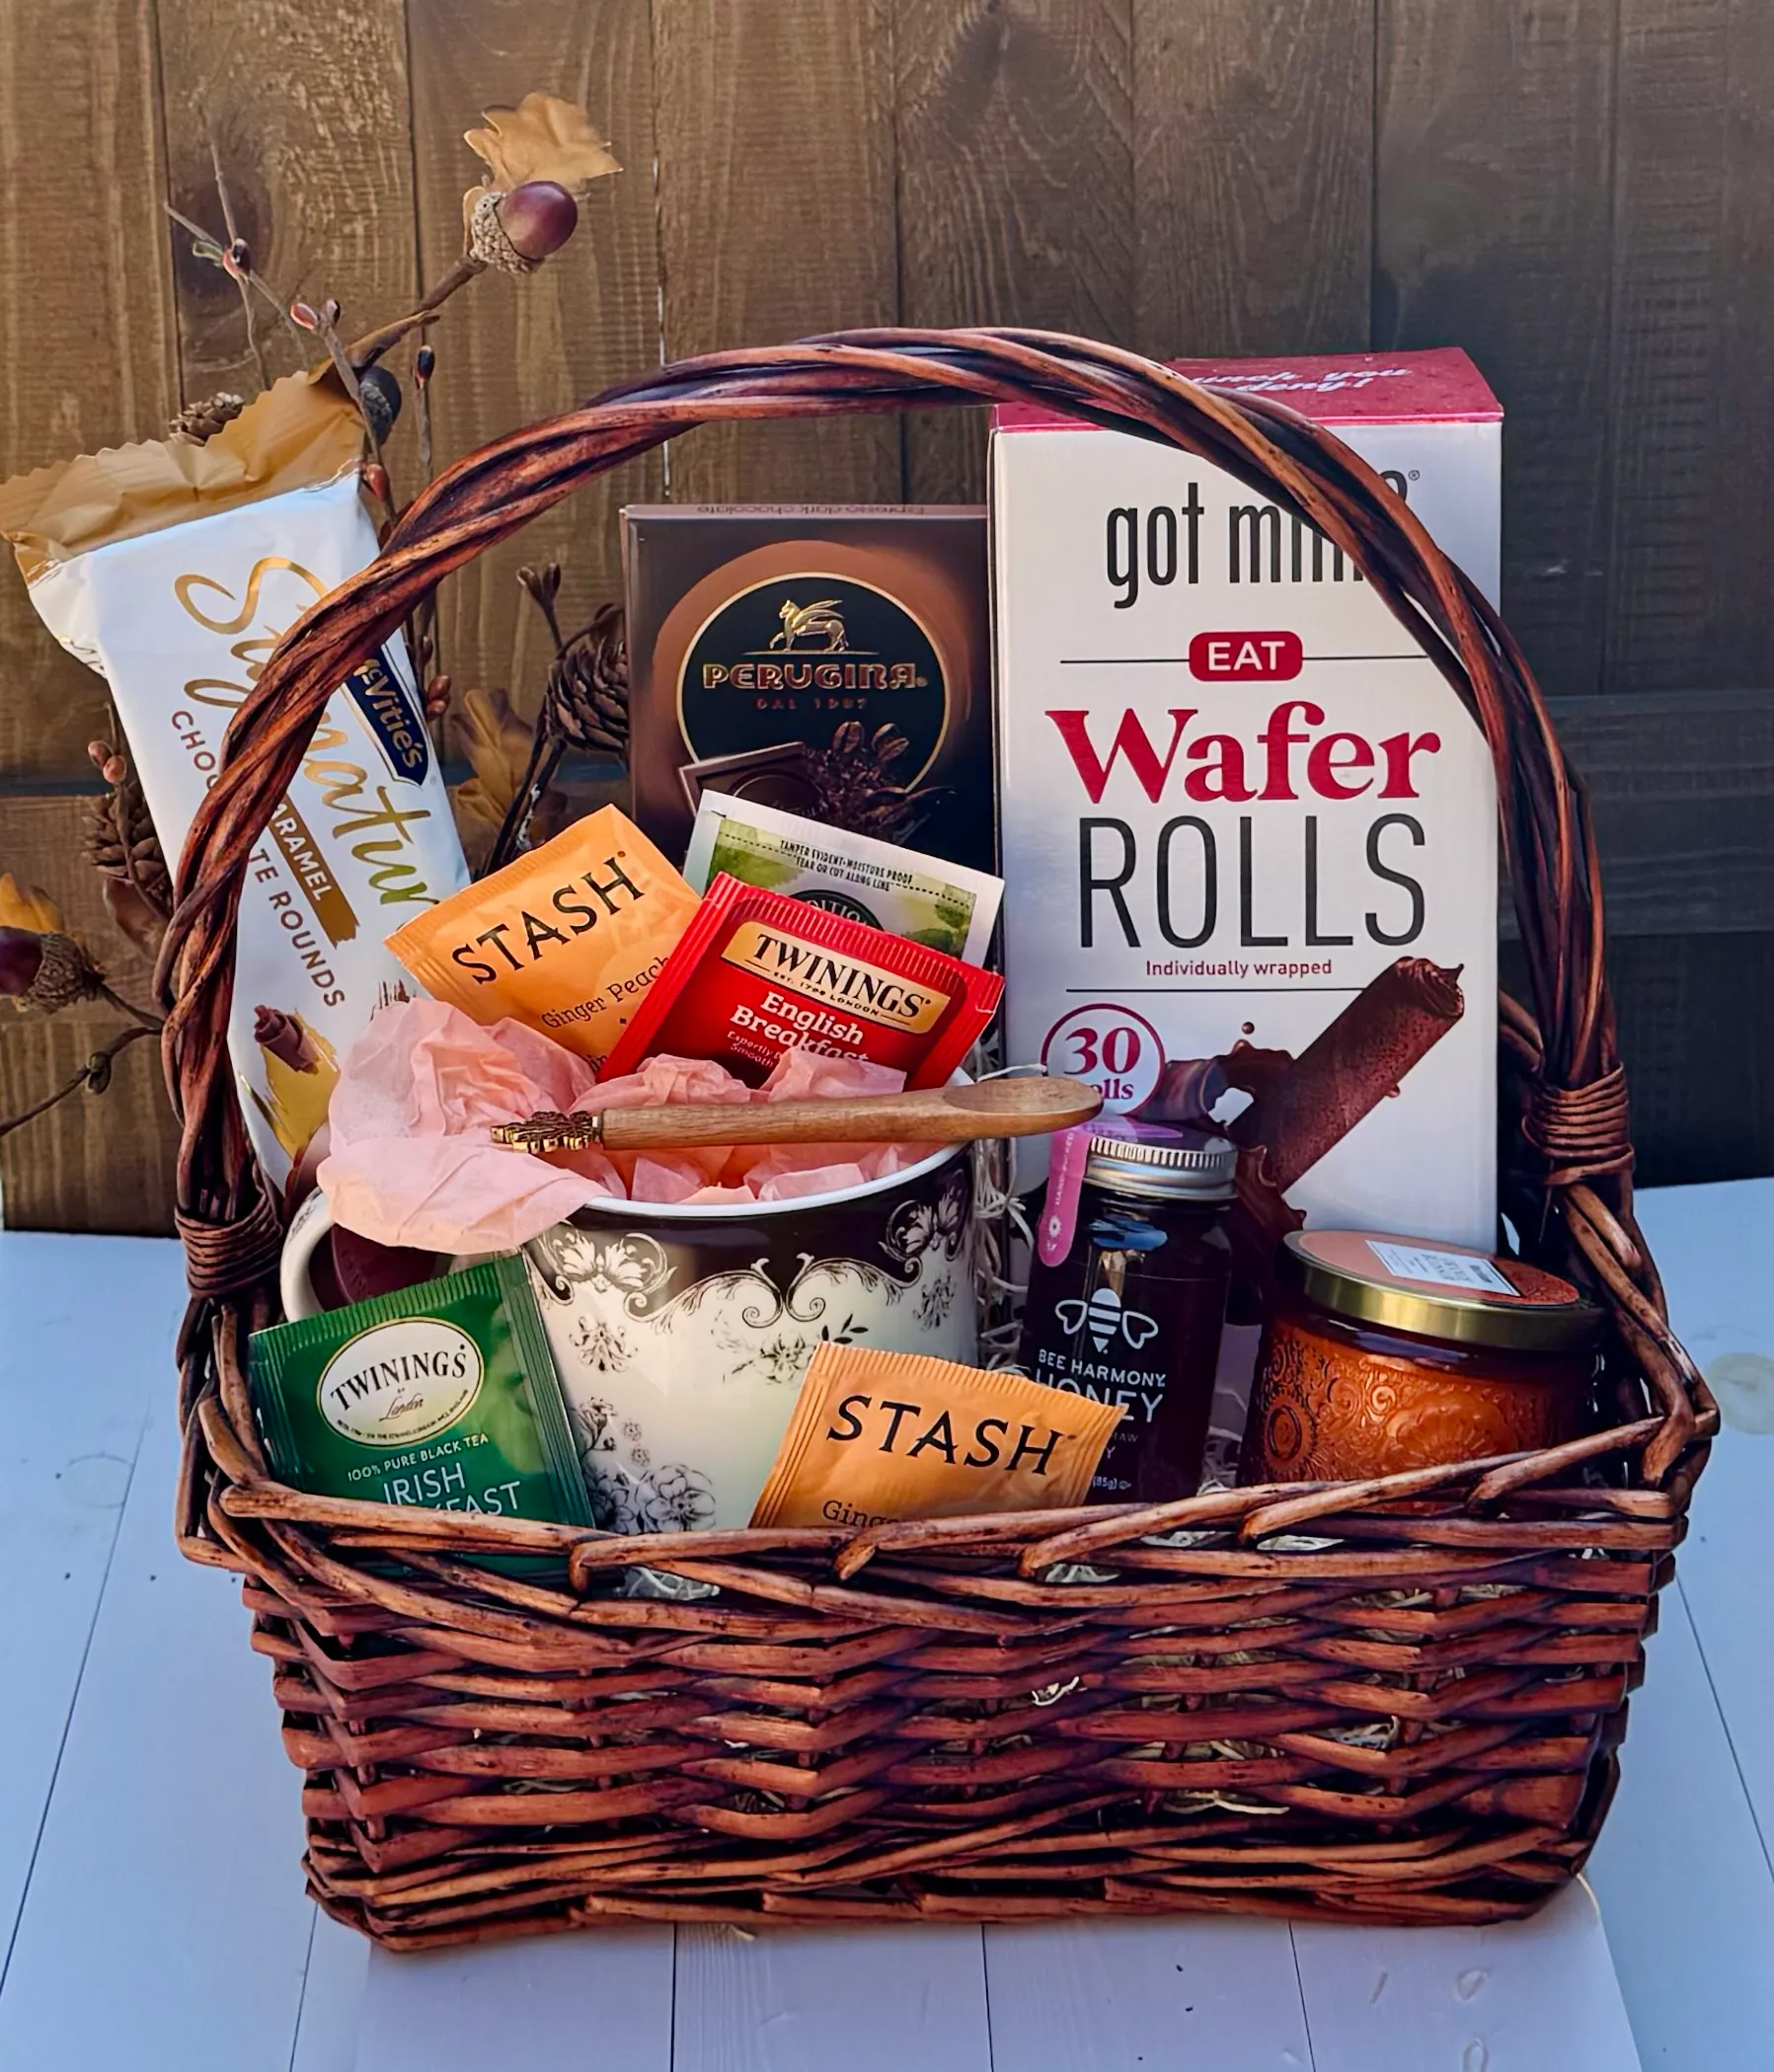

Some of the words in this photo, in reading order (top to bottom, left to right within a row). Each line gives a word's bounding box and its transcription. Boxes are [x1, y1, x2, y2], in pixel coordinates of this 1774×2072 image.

[697, 504, 795, 514] chocolate
[802, 503, 842, 514] dark
[1107, 482, 1204, 609] got
[703, 662, 917, 690] PERUGINA
[1207, 641, 1285, 672] EAT
[756, 698, 798, 710] DAL
[1044, 700, 1441, 804] Wafer
[271, 802, 333, 901] ARAMEL
[780, 840, 810, 857] TAMPER
[886, 870, 913, 885] PROOF
[796, 856, 815, 871] TEAR
[816, 863, 828, 875] OR
[829, 866, 845, 879] CUT
[1079, 813, 1426, 949] ROLLS
[451, 857, 646, 985] STASH
[269, 890, 346, 1007] ROUNDS
[1146, 959, 1249, 979] Individually
[1254, 959, 1333, 979] wrapped
[753, 934, 925, 1020] TWININGS
[541, 997, 607, 1029] Ginger
[760, 990, 865, 1046] English
[829, 994, 880, 1017] LONDON
[1063, 1027, 1141, 1075] 30
[1090, 1078, 1134, 1100] olls
[330, 1350, 467, 1412] TWININGS
[1038, 1348, 1066, 1370] BEE
[1070, 1359, 1167, 1388] HARMONY
[347, 1464, 381, 1482] 100%
[384, 1453, 417, 1472] PURE
[421, 1440, 462, 1462] BLACK
[463, 1433, 489, 1450] TEA
[826, 1395, 1064, 1476] STASH
[383, 1462, 465, 1506] IRISH
